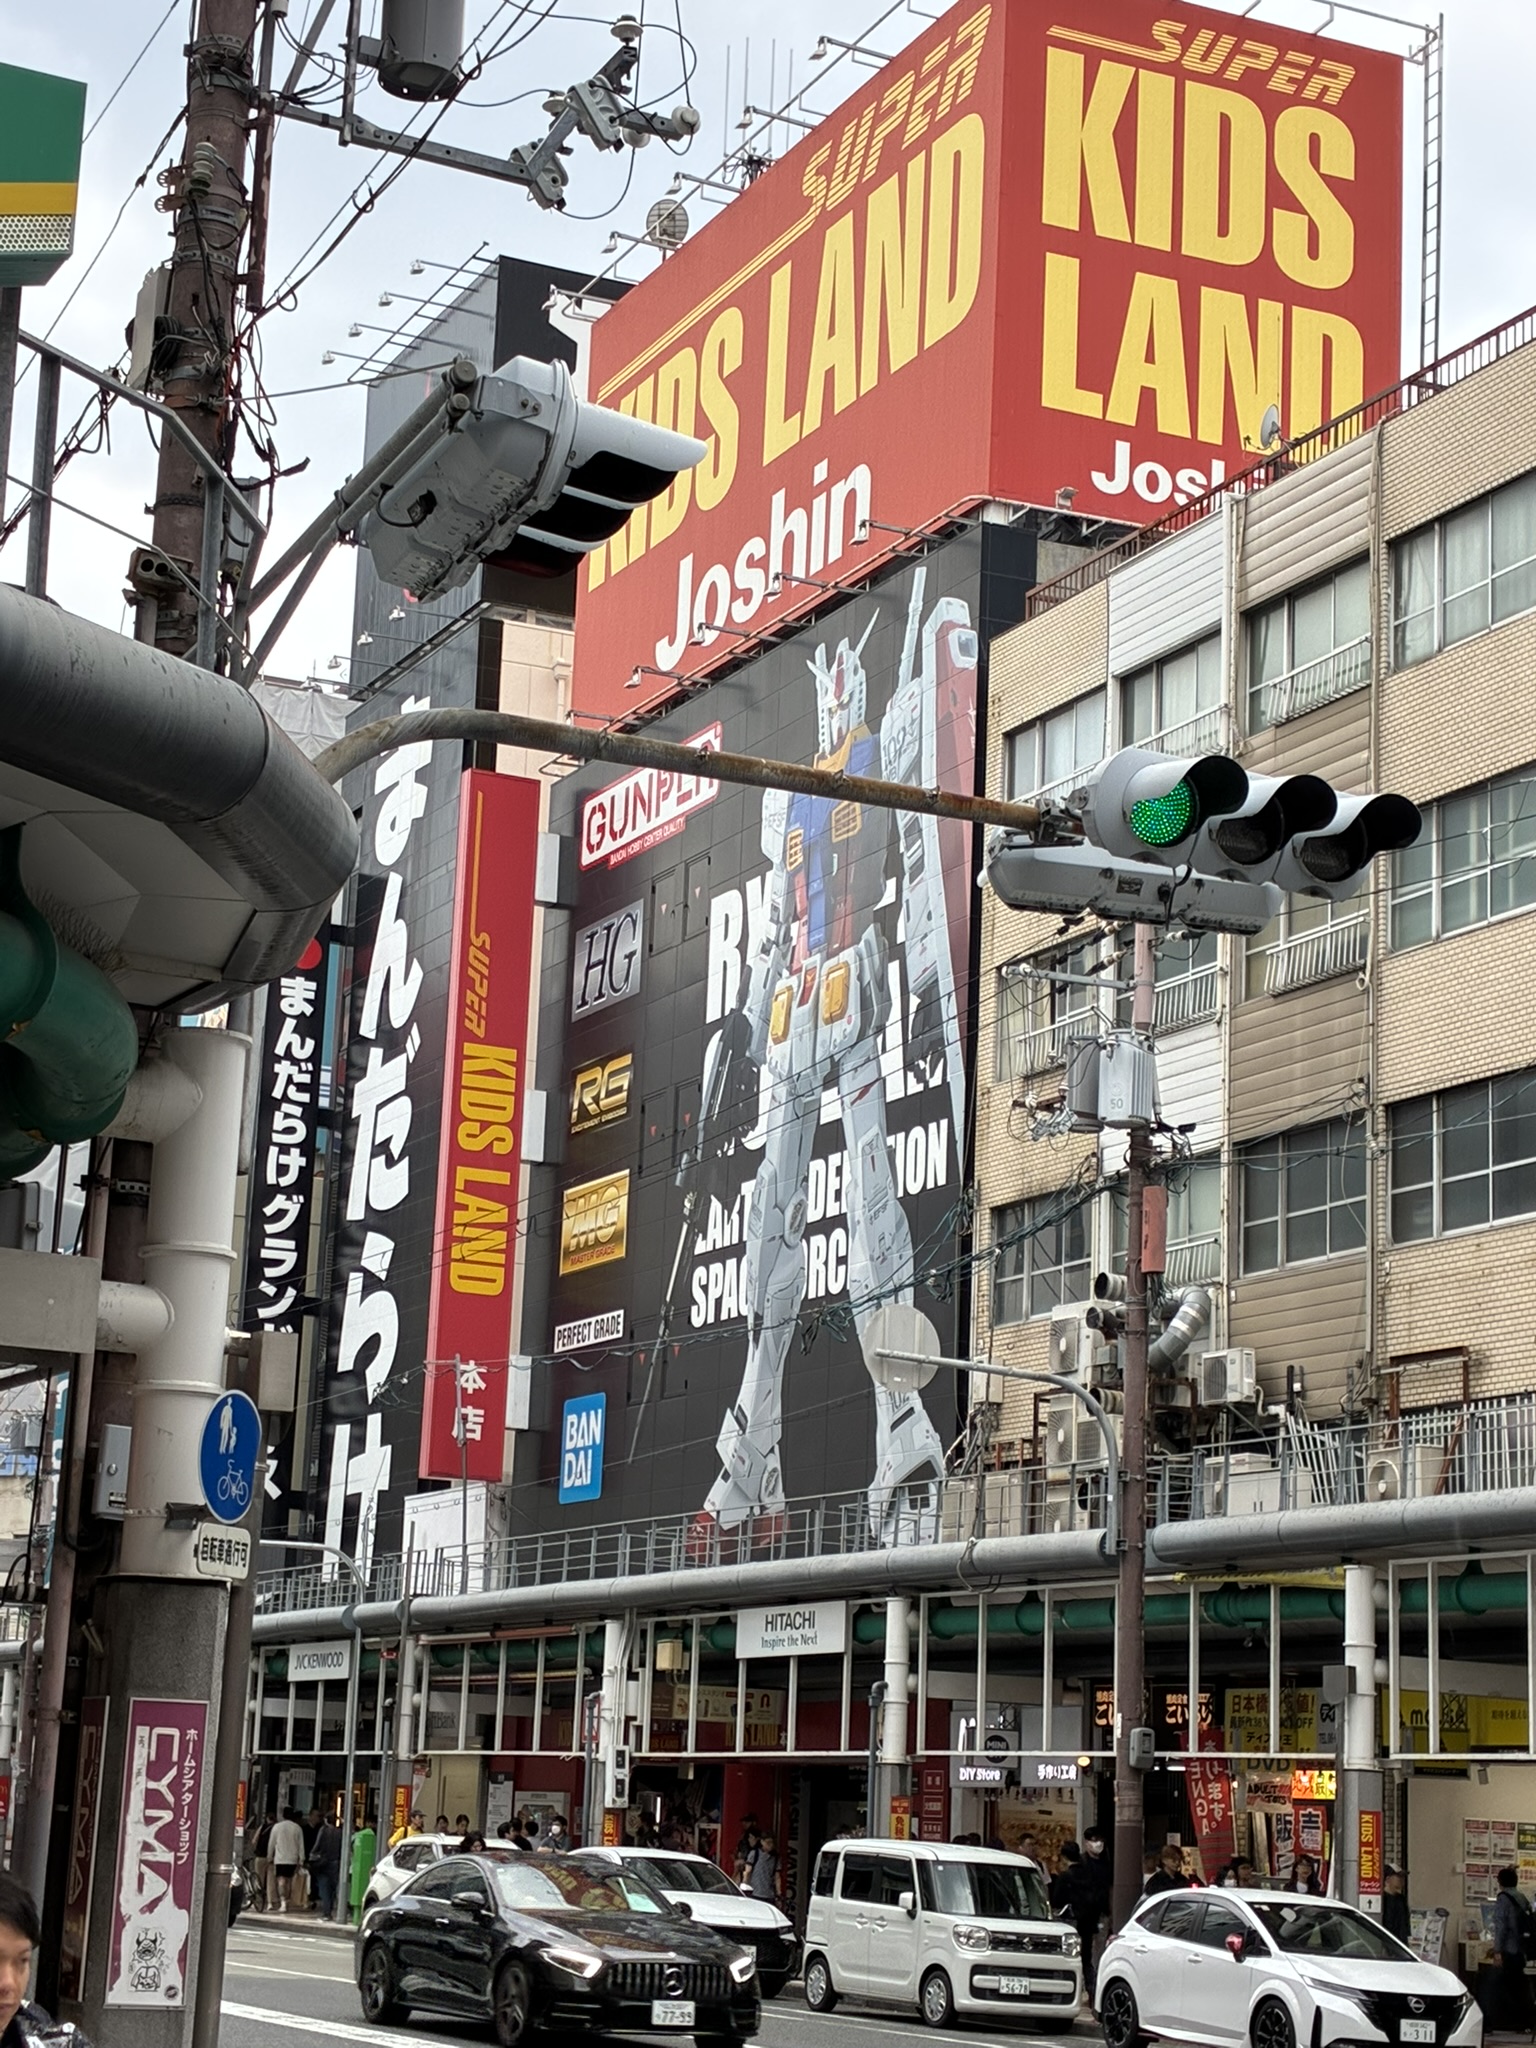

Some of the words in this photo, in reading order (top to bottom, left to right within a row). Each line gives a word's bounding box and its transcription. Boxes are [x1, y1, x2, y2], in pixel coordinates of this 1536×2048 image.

[1151, 20, 1355, 105] SUPER
[802, 4, 992, 217] SUPER
[1042, 46, 1355, 290] KIDS
[763, 113, 985, 467] LAND
[1040, 252, 1364, 460] LAND
[655, 458, 872, 671] Joshin
[663, 818, 685, 838] QUALITY
[464, 931, 491, 1039] SUPER
[575, 909, 639, 1012] HG
[457, 1042, 517, 1155] KIDS
[571, 1053, 632, 1123] RG
[1110, 1099, 1123, 1109] 50
[322, 695, 433, 1588] まんだらけ
[449, 1166, 511, 1296] LAND
[570, 1186, 620, 1251] MG
[570, 1250, 594, 1266] MASTER
[596, 1244, 615, 1260] GRADE
[556, 1322, 592, 1350] PERFECT
[594, 1314, 621, 1340] GRADE
[452, 1360, 487, 1441] 本店
[565, 1408, 602, 1450] BAN
[563, 1449, 592, 1489] DAI
[761, 1635, 786, 1651] Inspire
[787, 1634, 799, 1647] the
[800, 1630, 818, 1646] Next
[765, 1610, 815, 1632] HITACHI
[294, 1651, 344, 1670] JVCKENWOOD
[176, 1728, 199, 1865] ホームシアターショップ
[960, 1767, 976, 1780] DIY
[976, 1768, 1001, 1781] Store
[1247, 1758, 1291, 1771] DVD
[1247, 1783, 1279, 1795] ADULT
[138, 1727, 180, 1914] CYMA
[1361, 1815, 1373, 1843] KIDS
[1361, 1847, 1372, 1878] LAND
